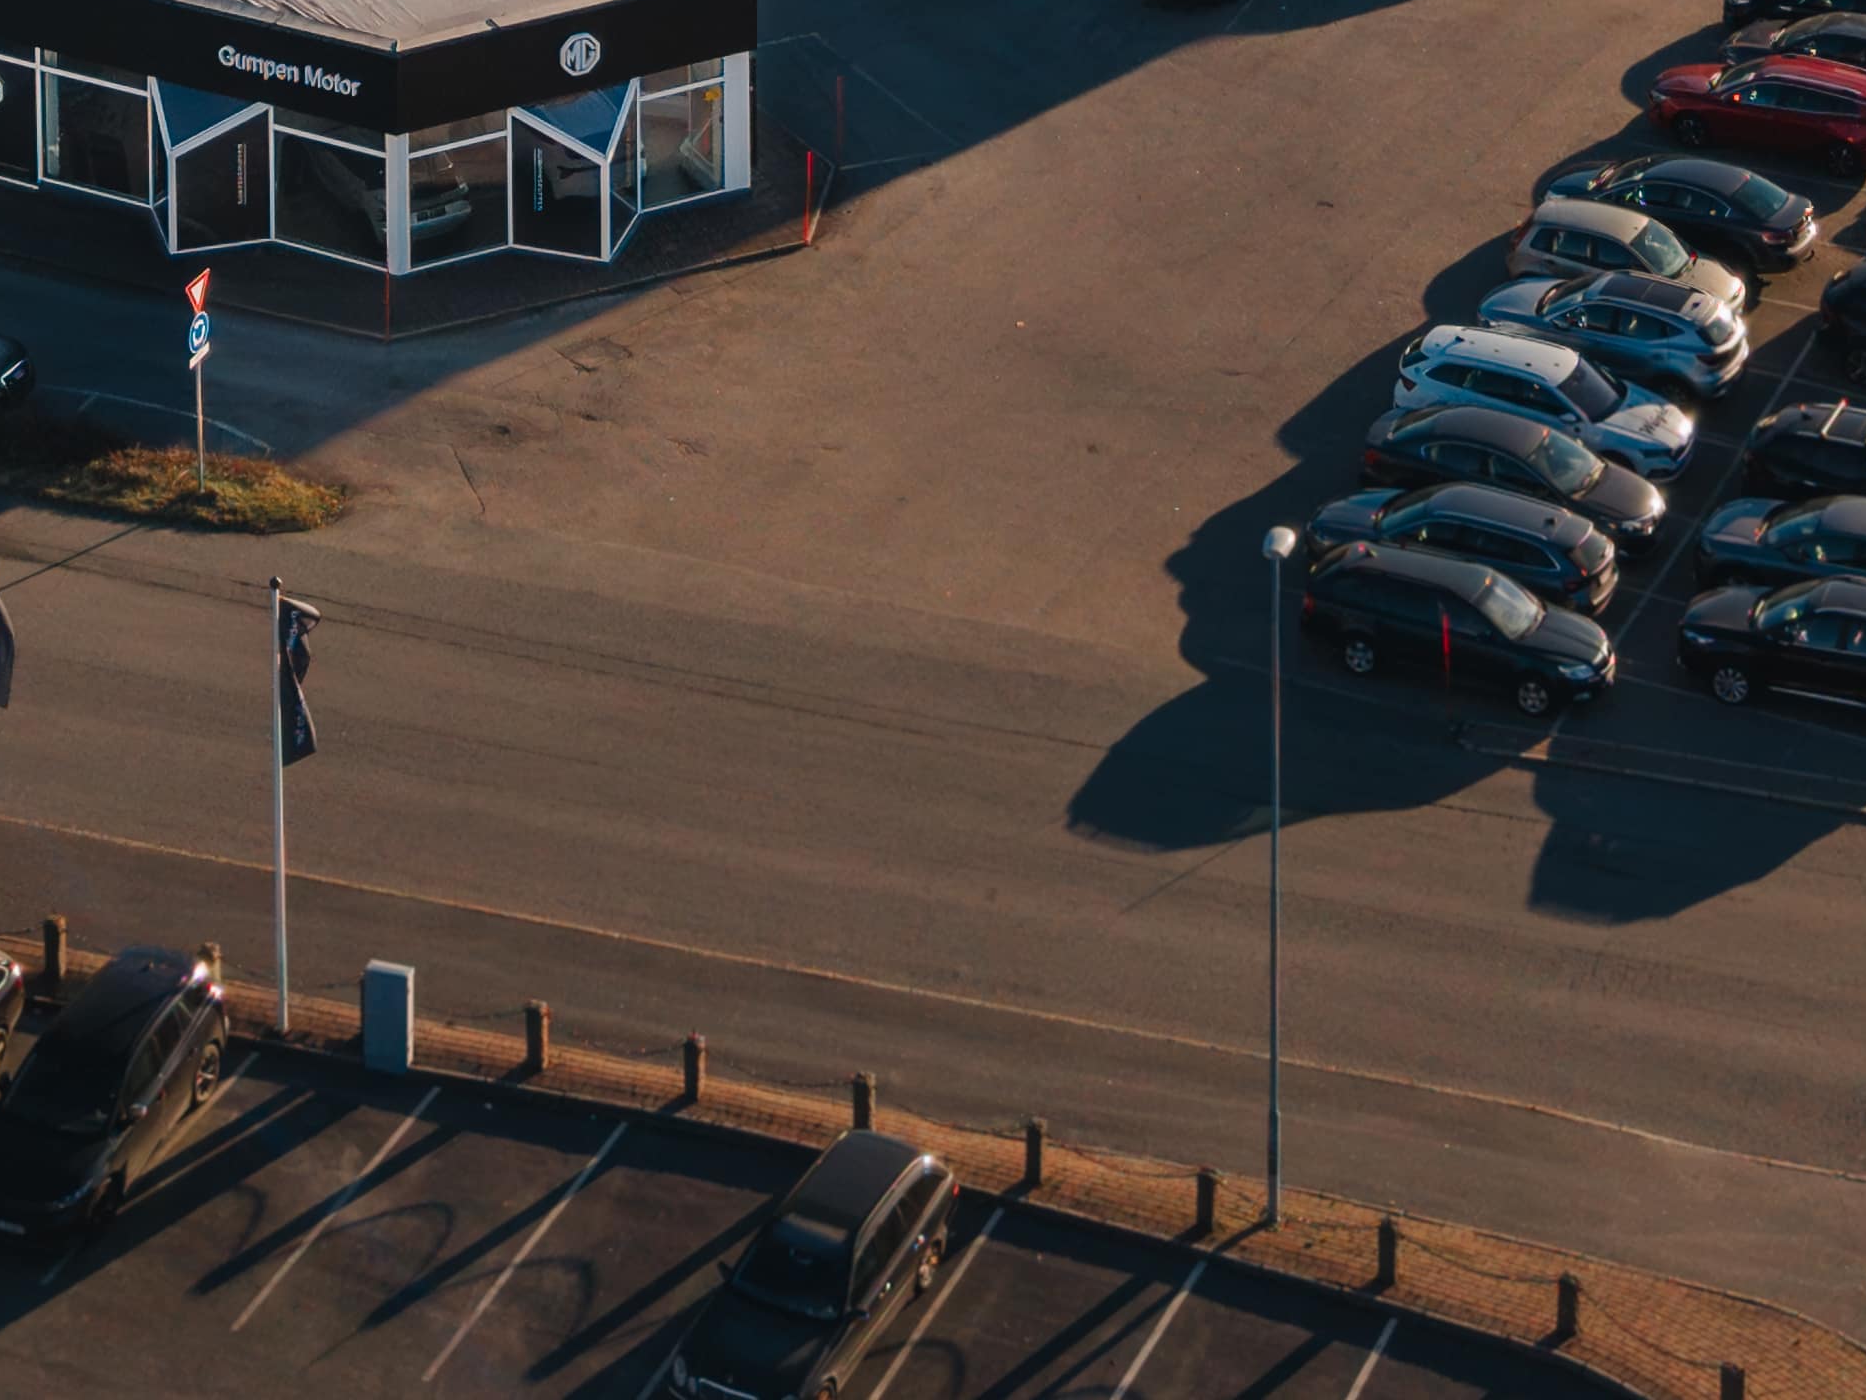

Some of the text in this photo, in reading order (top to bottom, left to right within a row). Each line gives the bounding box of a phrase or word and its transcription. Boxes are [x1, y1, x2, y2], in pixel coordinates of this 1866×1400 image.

[217, 44, 363, 97] Gumpen Motor
[563, 36, 598, 74] MG
